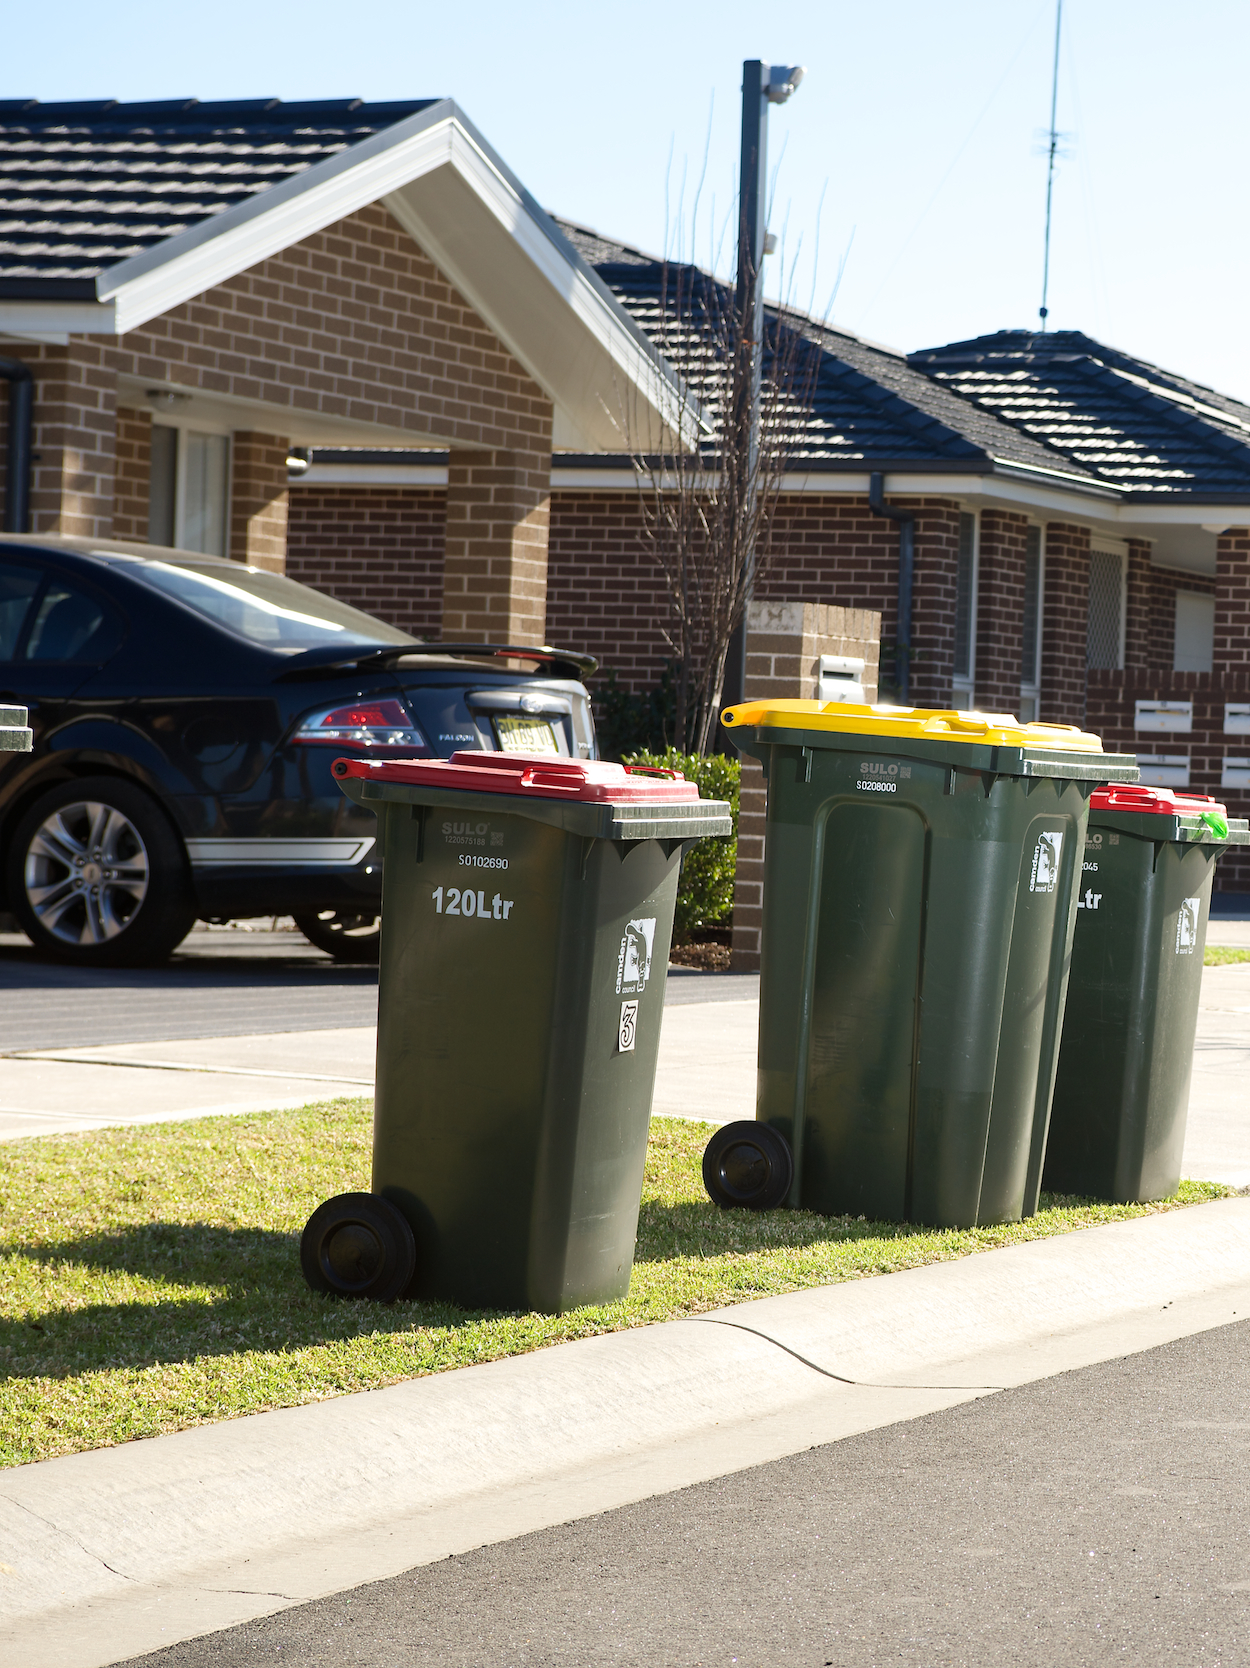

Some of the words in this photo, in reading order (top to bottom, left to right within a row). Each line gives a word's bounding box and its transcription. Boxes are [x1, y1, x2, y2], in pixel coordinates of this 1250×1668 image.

[438, 732, 475, 743] FALCON
[860, 762, 899, 776] SULO
[856, 780, 897, 793] S0208000
[441, 821, 488, 836] SULO
[458, 854, 509, 870] S0102690
[1029, 845, 1040, 892] camden
[431, 886, 515, 920] 120Ltr
[615, 937, 627, 994] camden
[621, 984, 636, 994] council
[620, 1004, 637, 1049] 3
